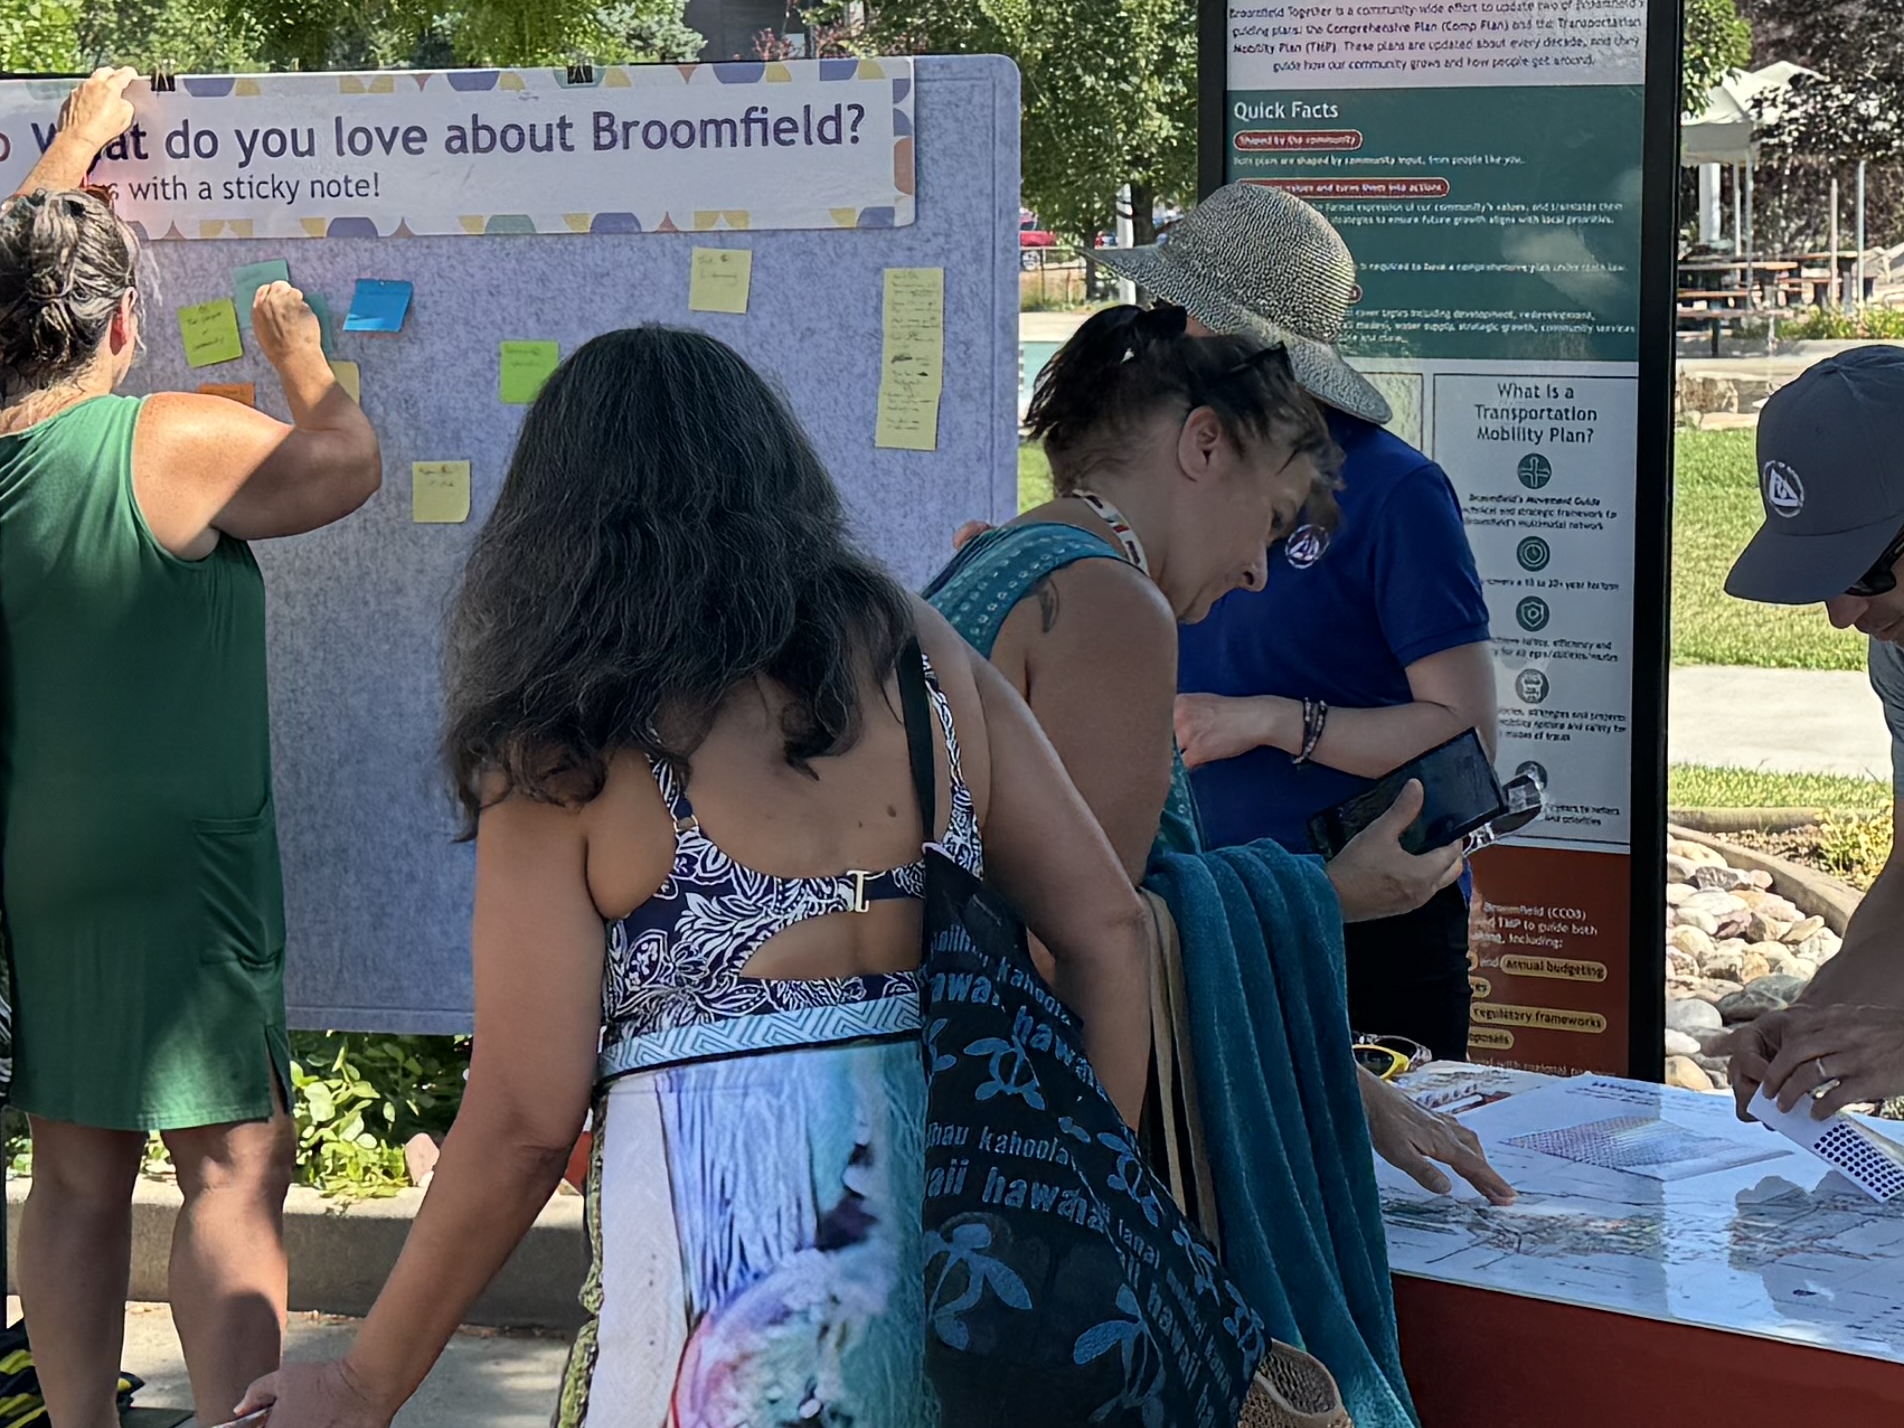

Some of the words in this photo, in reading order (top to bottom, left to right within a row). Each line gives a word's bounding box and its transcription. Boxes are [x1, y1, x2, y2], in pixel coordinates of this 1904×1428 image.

[1233, 101, 1284, 121] Quick
[1291, 101, 1338, 118] Facts
[165, 118, 218, 159] do
[234, 127, 315, 165] you
[334, 115, 427, 156] love
[444, 113, 574, 154] about
[592, 102, 864, 150] Broomfield?
[128, 174, 187, 200] with
[198, 181, 212, 199] a
[222, 173, 299, 205] sticky
[310, 171, 379, 198] note!
[1497, 382, 1540, 398] What
[1564, 387, 1573, 399] a
[1474, 404, 1597, 428] Transportation
[1477, 425, 1543, 445] Mobility
[1549, 426, 1593, 442] Plan?
